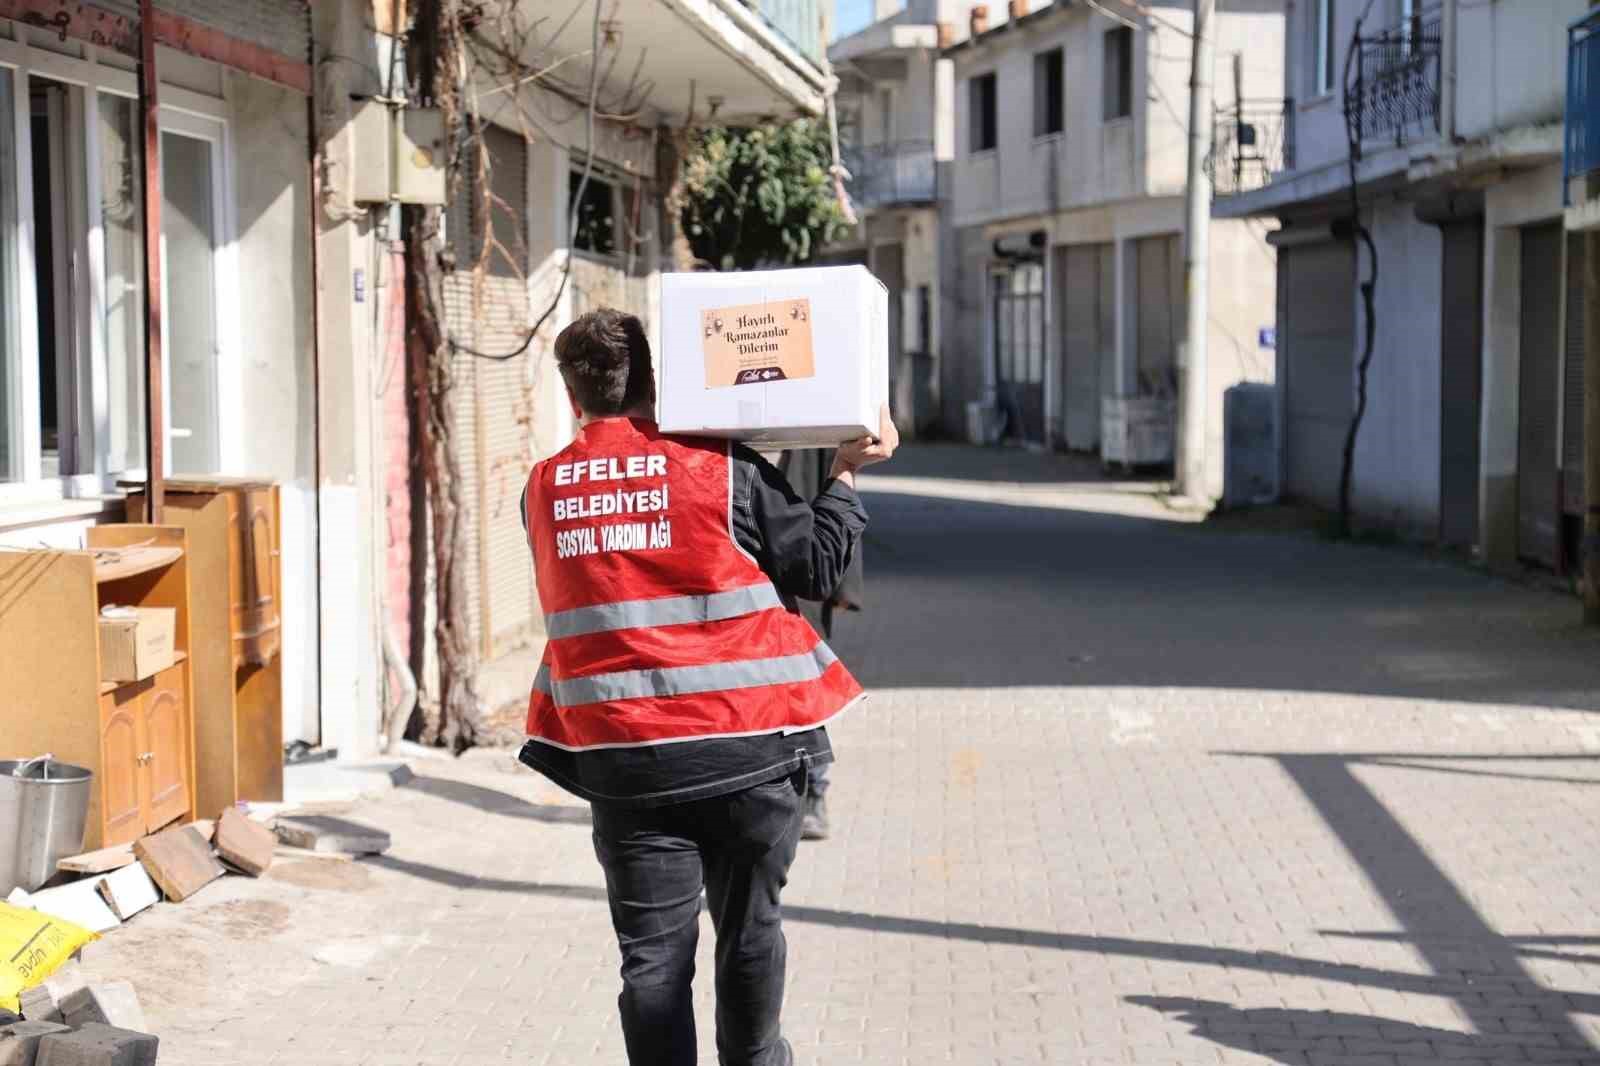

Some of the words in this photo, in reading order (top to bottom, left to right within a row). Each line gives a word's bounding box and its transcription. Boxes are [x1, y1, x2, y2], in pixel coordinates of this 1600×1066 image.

[736, 313, 775, 329] Hayırlı
[724, 326, 789, 344] Ramazanlar
[736, 341, 779, 355] Dilerim
[554, 454, 667, 486] EFELER
[553, 483, 669, 521] BELEDİYESİ
[556, 527, 599, 559] SOSYAL
[600, 523, 647, 552] YARDIM
[649, 513, 672, 549] AĞI
